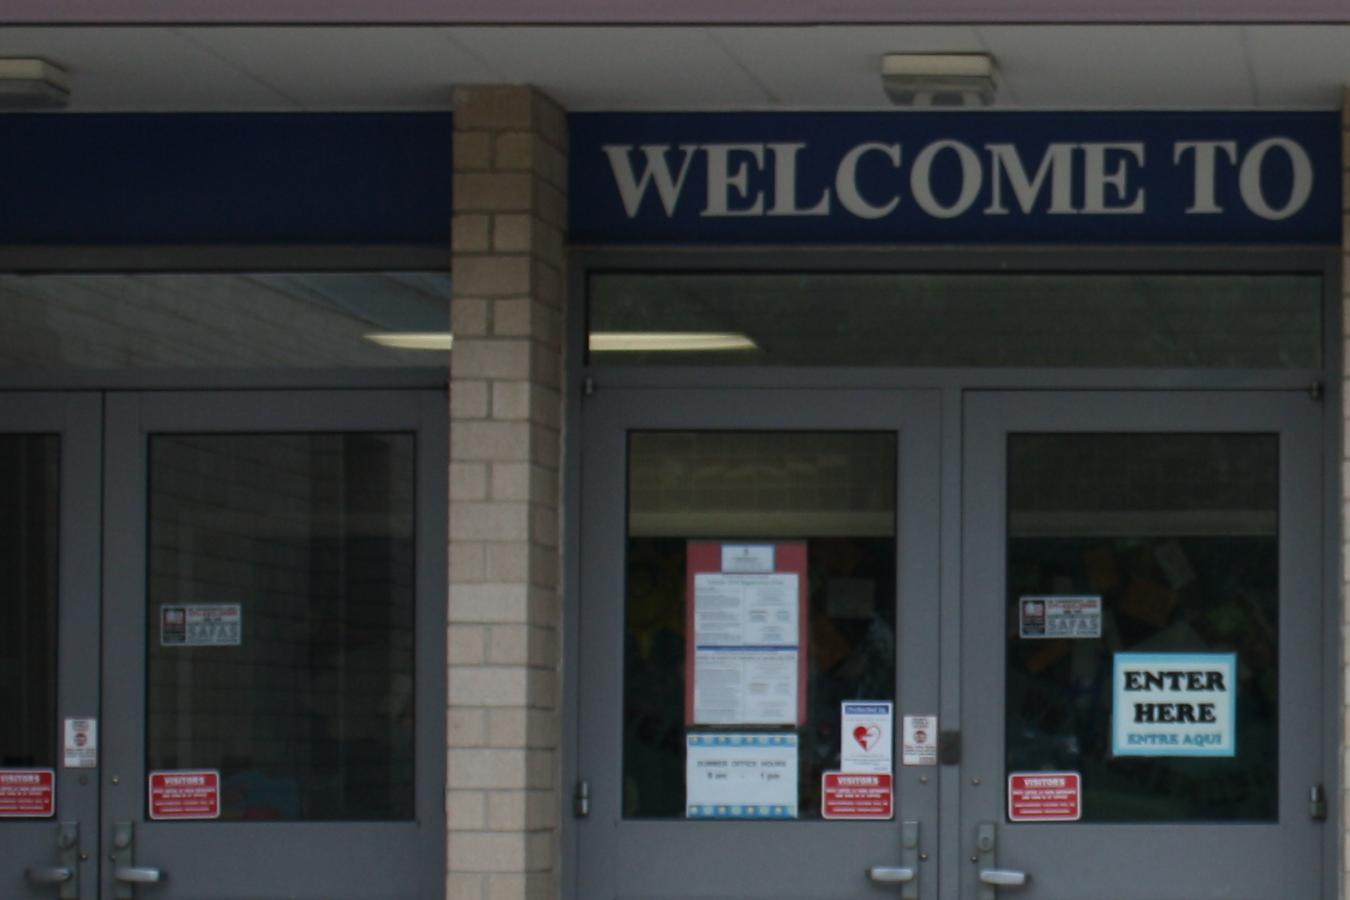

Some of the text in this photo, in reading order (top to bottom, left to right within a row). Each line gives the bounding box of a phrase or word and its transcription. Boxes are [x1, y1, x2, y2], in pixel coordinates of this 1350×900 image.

[602, 137, 1315, 220] WELCOME TO
[1123, 670, 1227, 692] ENTER
[1133, 703, 1217, 723] HERE
[1126, 733, 1222, 747] ENTRE AQUI
[731, 760, 757, 768] OFFICE
[761, 760, 787, 768] HOURS
[164, 775, 205, 785] VISITORS
[1023, 778, 1066, 788] VISITORS
